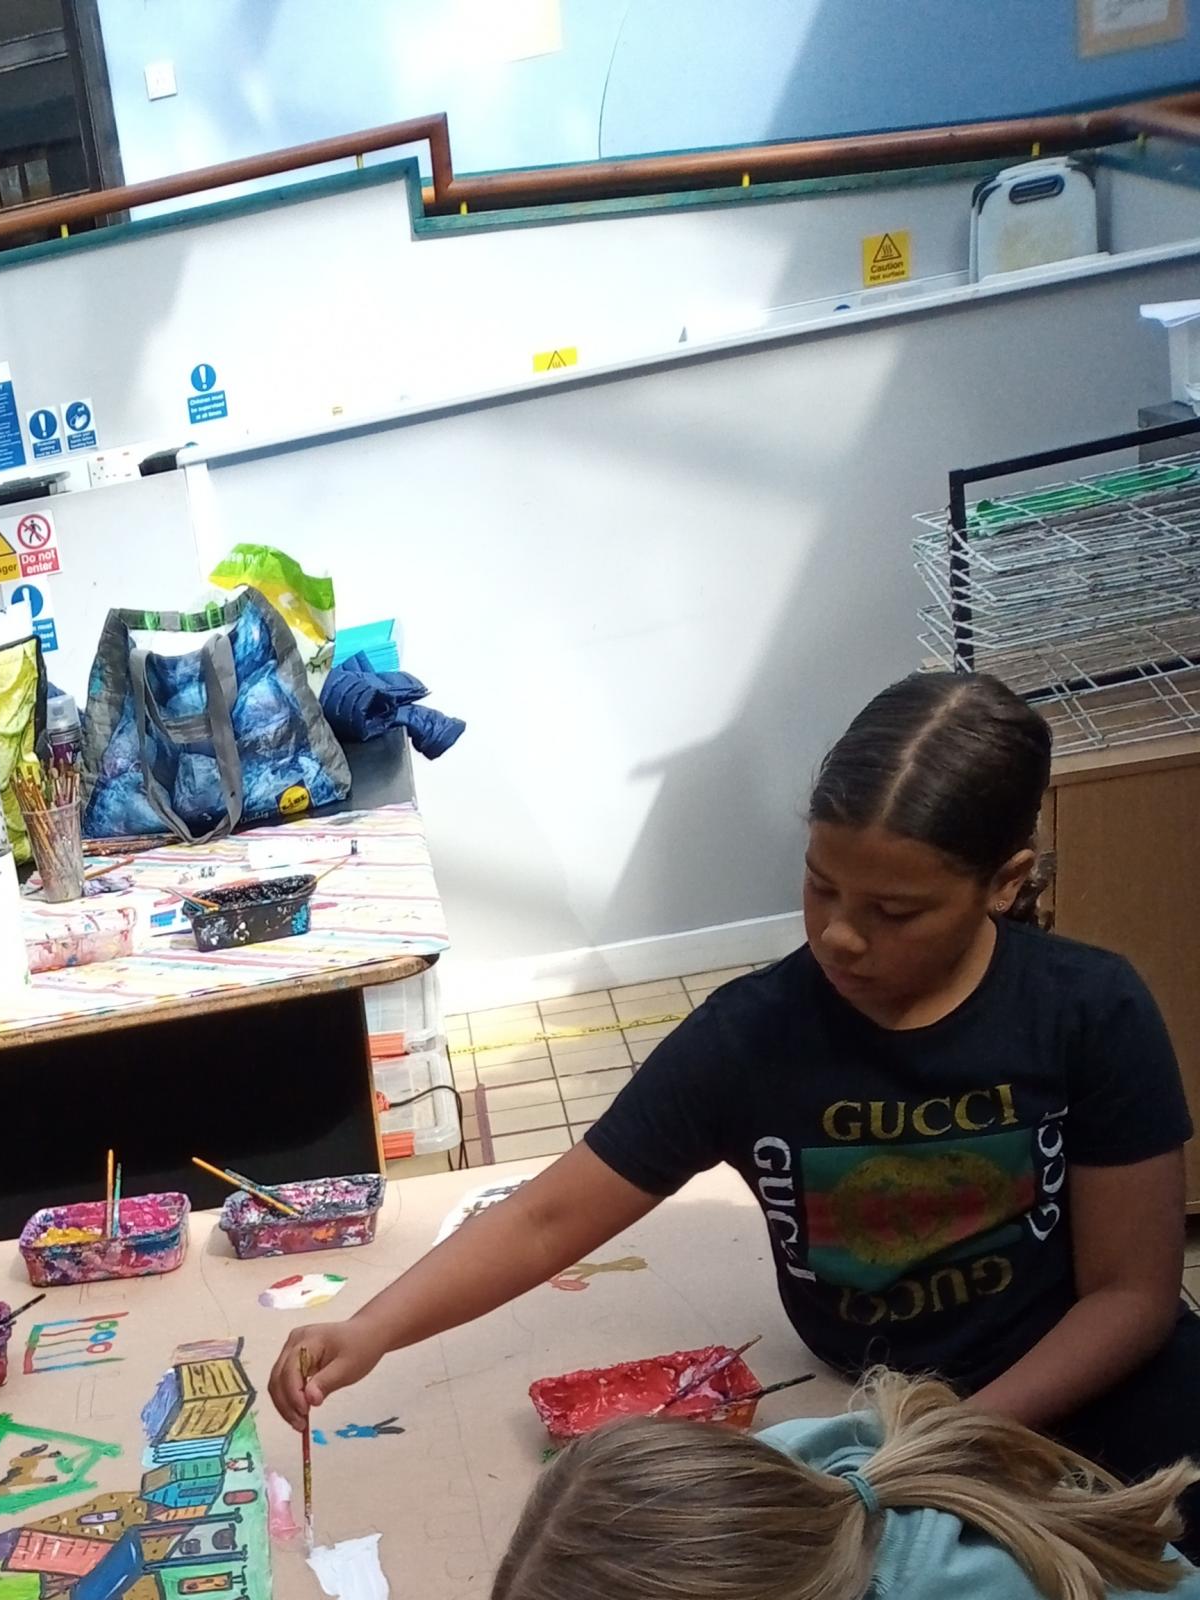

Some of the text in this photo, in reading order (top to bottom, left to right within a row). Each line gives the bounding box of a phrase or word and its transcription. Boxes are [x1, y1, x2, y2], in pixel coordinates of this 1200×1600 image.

[870, 261, 904, 273] Caution
[189, 393, 224, 406] Children must
[198, 401, 225, 412] supervised
[20, 549, 56, 565] Do not
[26, 561, 54, 575] enter
[822, 1083, 1020, 1142] GUCCI
